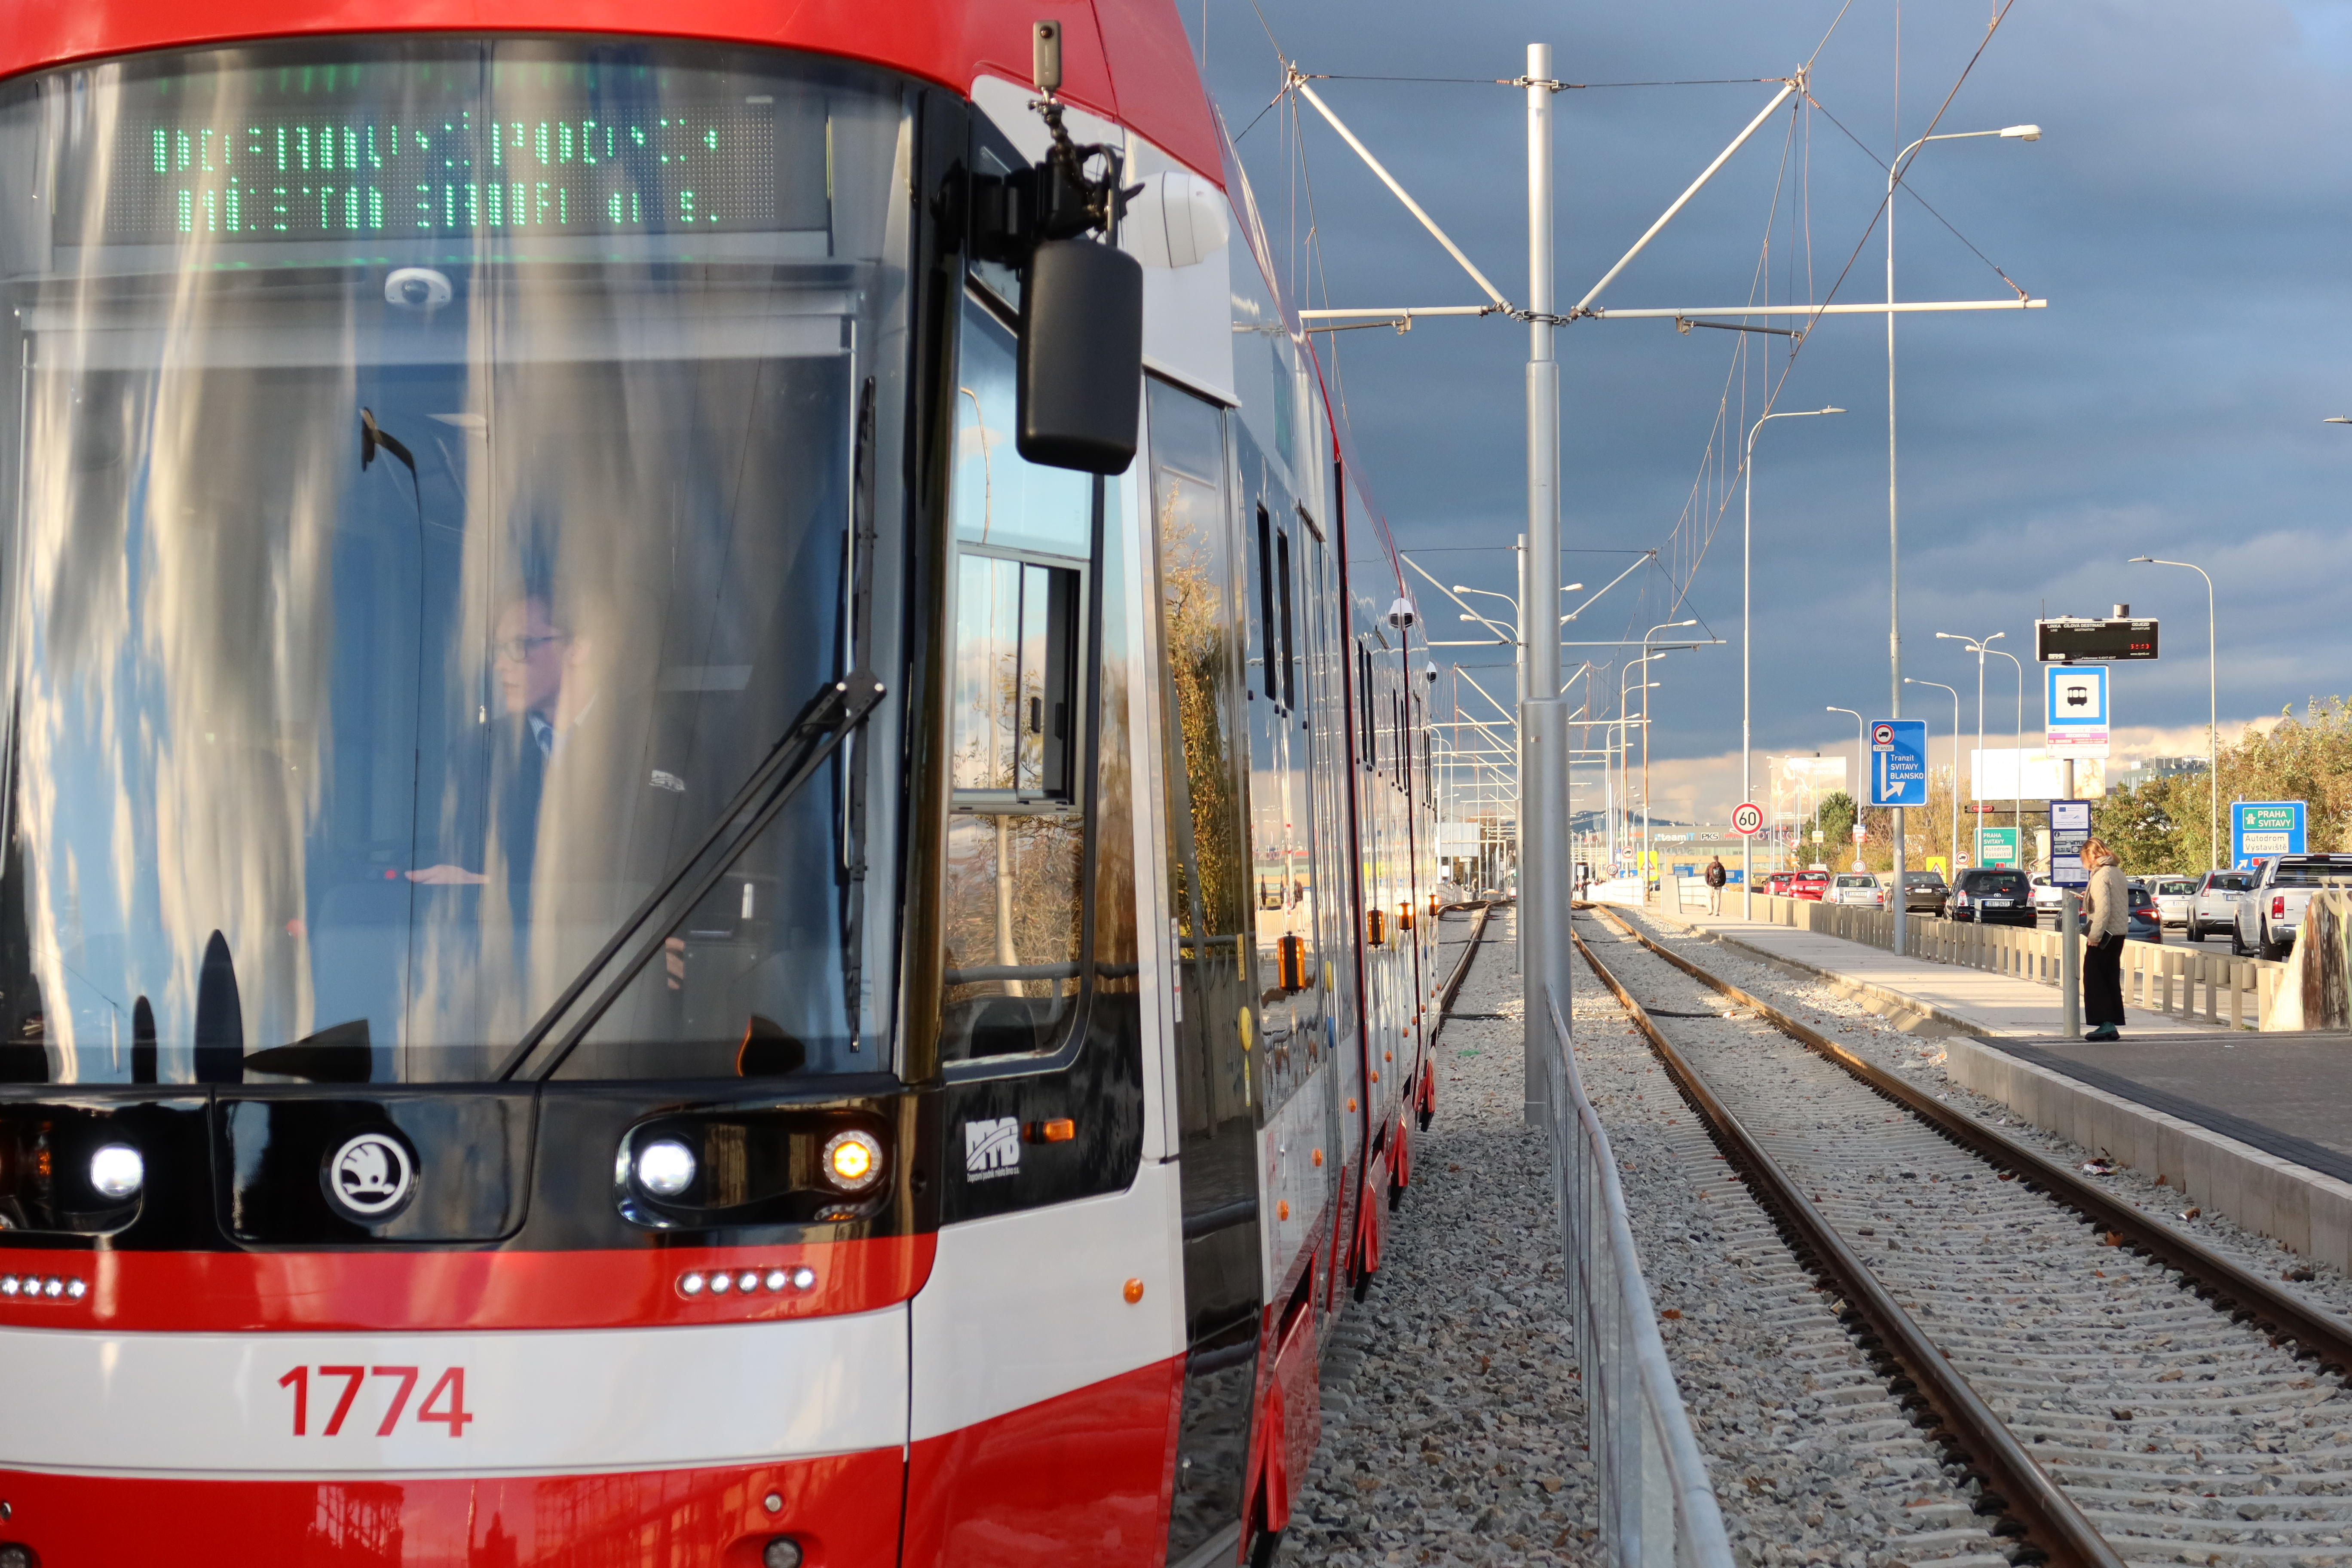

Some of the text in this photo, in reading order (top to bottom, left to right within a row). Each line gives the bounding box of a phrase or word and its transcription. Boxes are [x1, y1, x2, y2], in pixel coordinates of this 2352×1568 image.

[1739, 812, 1756, 826] 60
[1661, 833, 1695, 841] teamIT
[1701, 833, 1719, 841] PKS
[2245, 843, 2287, 852] Výstaviště
[967, 1171, 983, 1183] Dopravní
[983, 1169, 995, 1181] podnik
[276, 1365, 473, 1438] 1774
